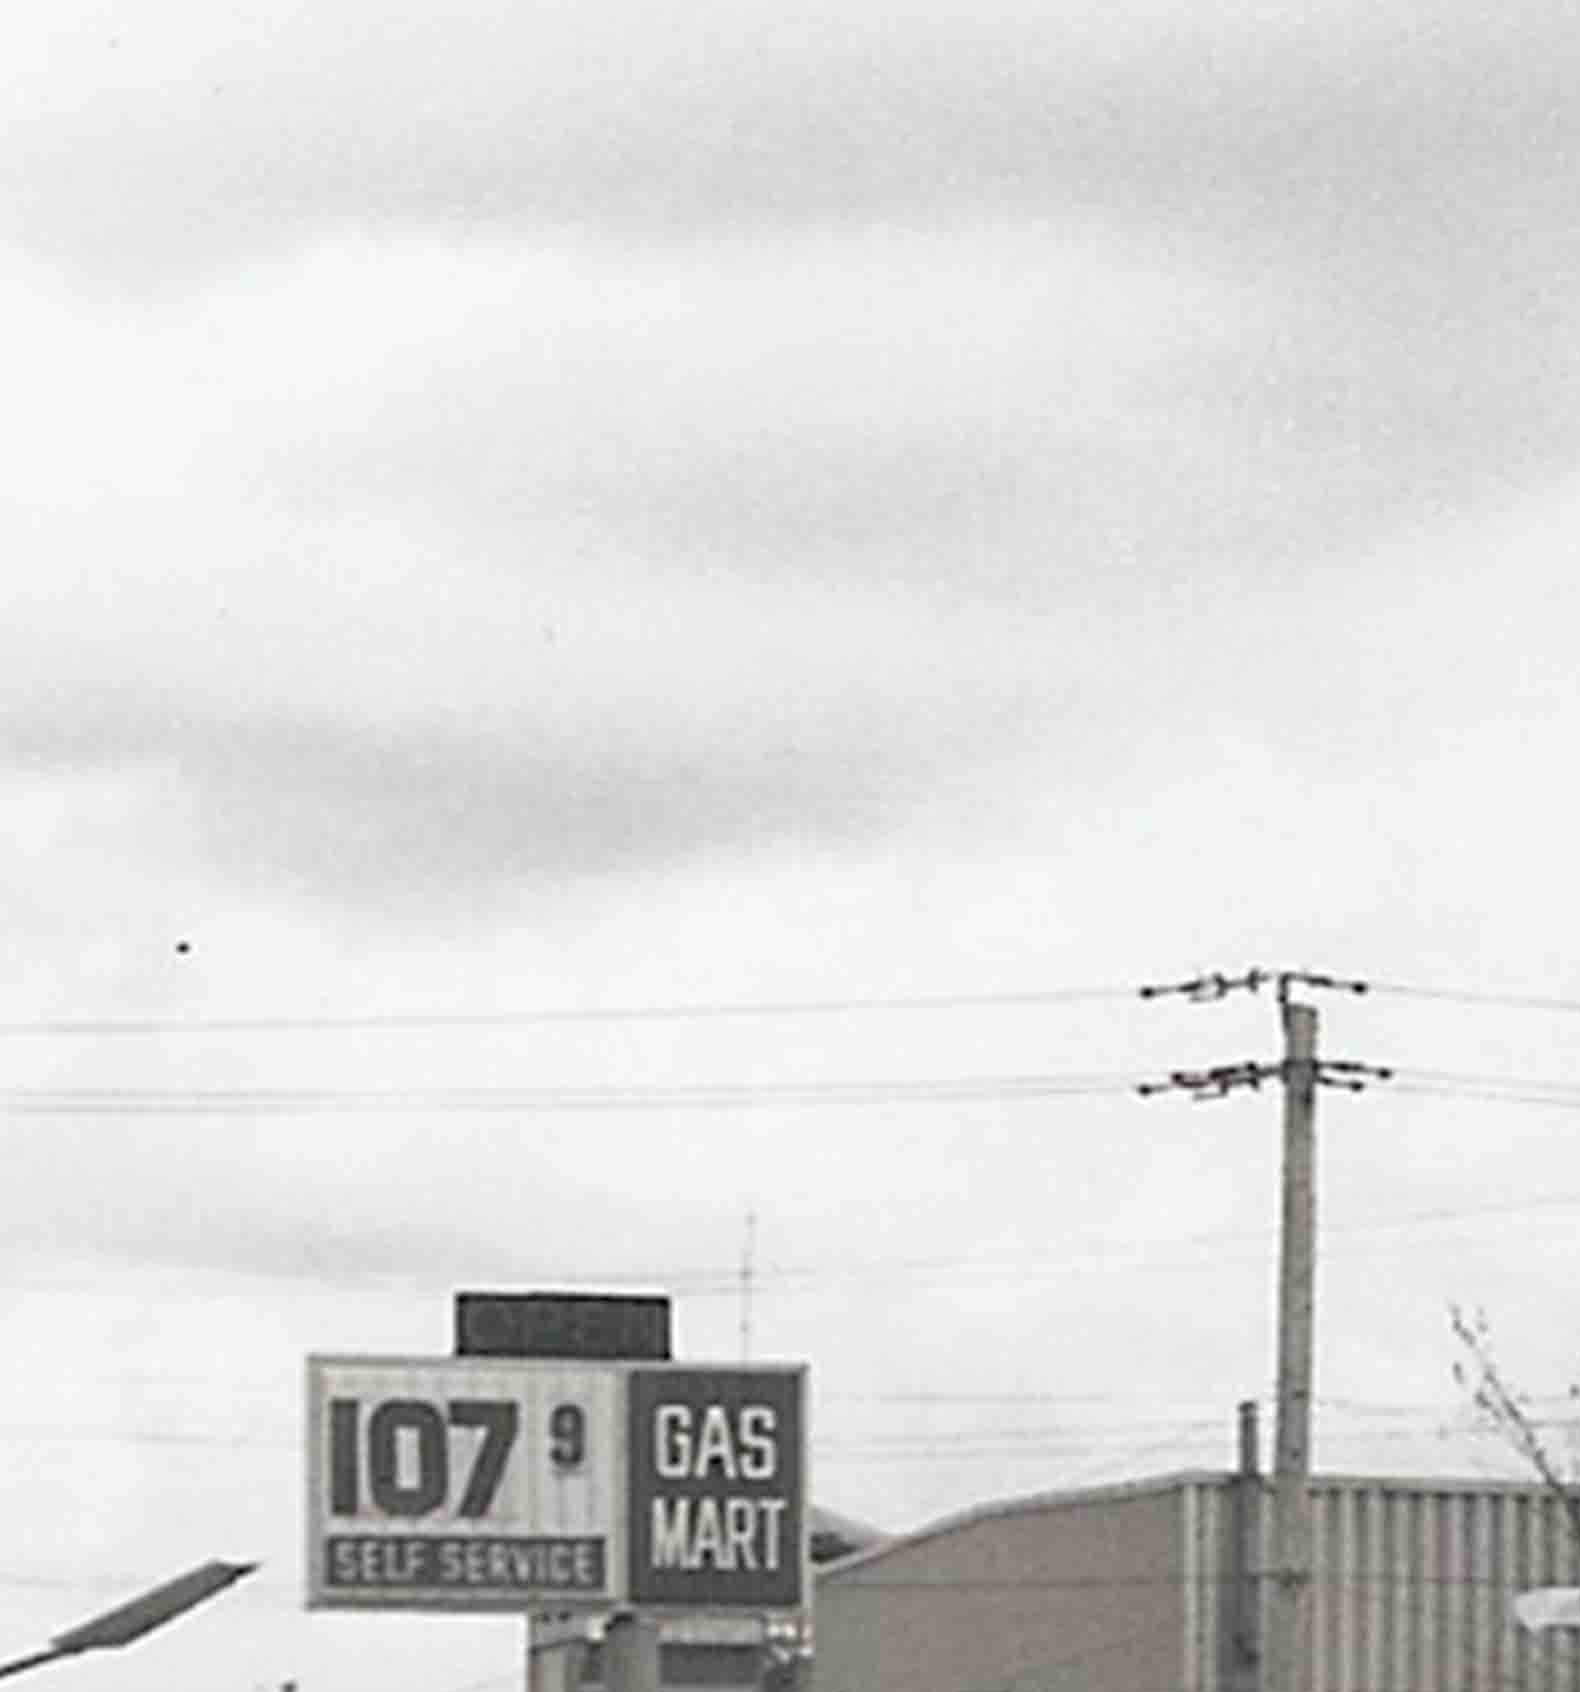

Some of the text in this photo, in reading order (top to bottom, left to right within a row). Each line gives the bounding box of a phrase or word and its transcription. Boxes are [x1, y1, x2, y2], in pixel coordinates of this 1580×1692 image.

[330, 1398, 586, 1518] 107 9
[656, 1404, 776, 1480] GAS
[334, 1540, 595, 1584] SELF SERVICE
[652, 1498, 788, 1571] MART
